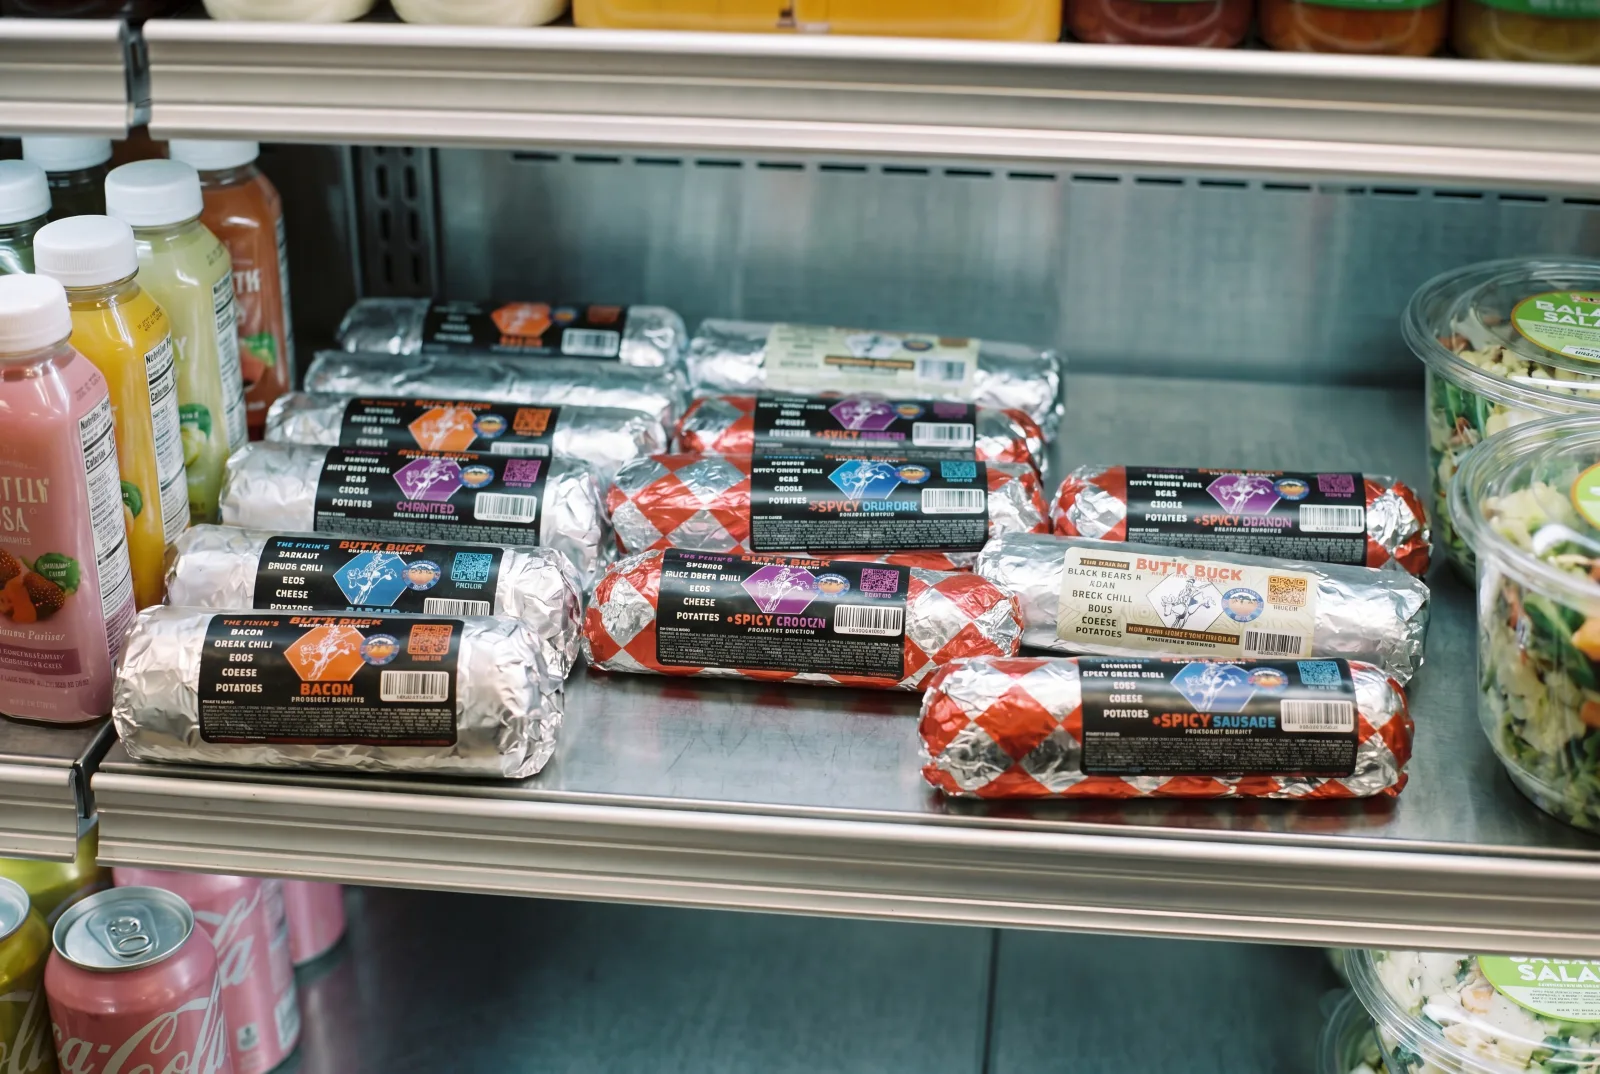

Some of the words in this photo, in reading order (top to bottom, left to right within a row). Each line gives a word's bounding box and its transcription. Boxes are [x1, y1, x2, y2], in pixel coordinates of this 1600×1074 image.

[386, 544, 426, 553] BUCK
[1068, 567, 1098, 578] BLACK
[1101, 571, 1132, 581] BEARS
[1136, 558, 1189, 576] BUT'K
[1194, 564, 1243, 581] BUCK
[276, 589, 308, 599] CHEESE
[1072, 590, 1103, 600] BRECK
[1106, 593, 1133, 604] CHILL
[682, 597, 716, 606] CHEESE
[230, 628, 264, 636] BACON
[1076, 626, 1122, 638] POTATOES
[248, 640, 273, 649] CHILI
[216, 684, 263, 693] POTATOES
[300, 683, 354, 696] BACON
[1103, 709, 1150, 719] POTATOES
